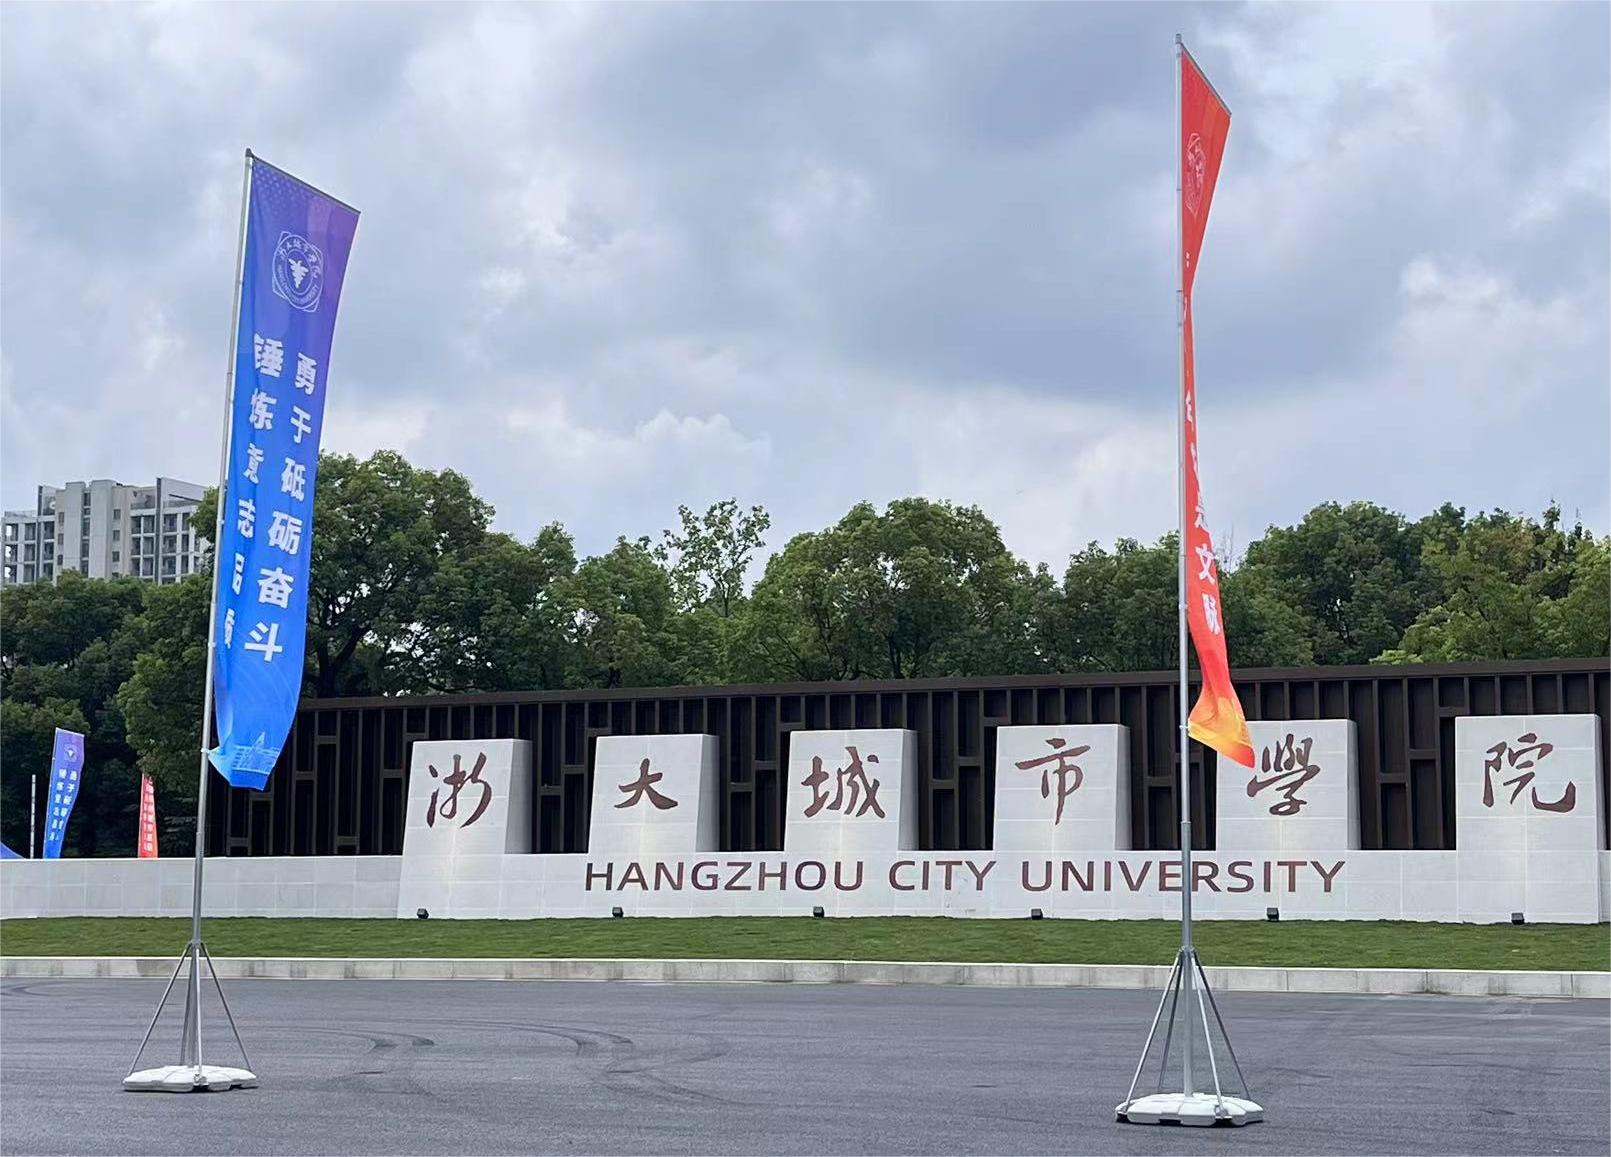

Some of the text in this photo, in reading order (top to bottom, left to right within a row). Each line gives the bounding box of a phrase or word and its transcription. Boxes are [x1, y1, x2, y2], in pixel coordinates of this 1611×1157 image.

[244, 352, 317, 663] 勇于砥砺奋斗
[585, 859, 1347, 893] HANGZHOU CITY UNIVERSITY
